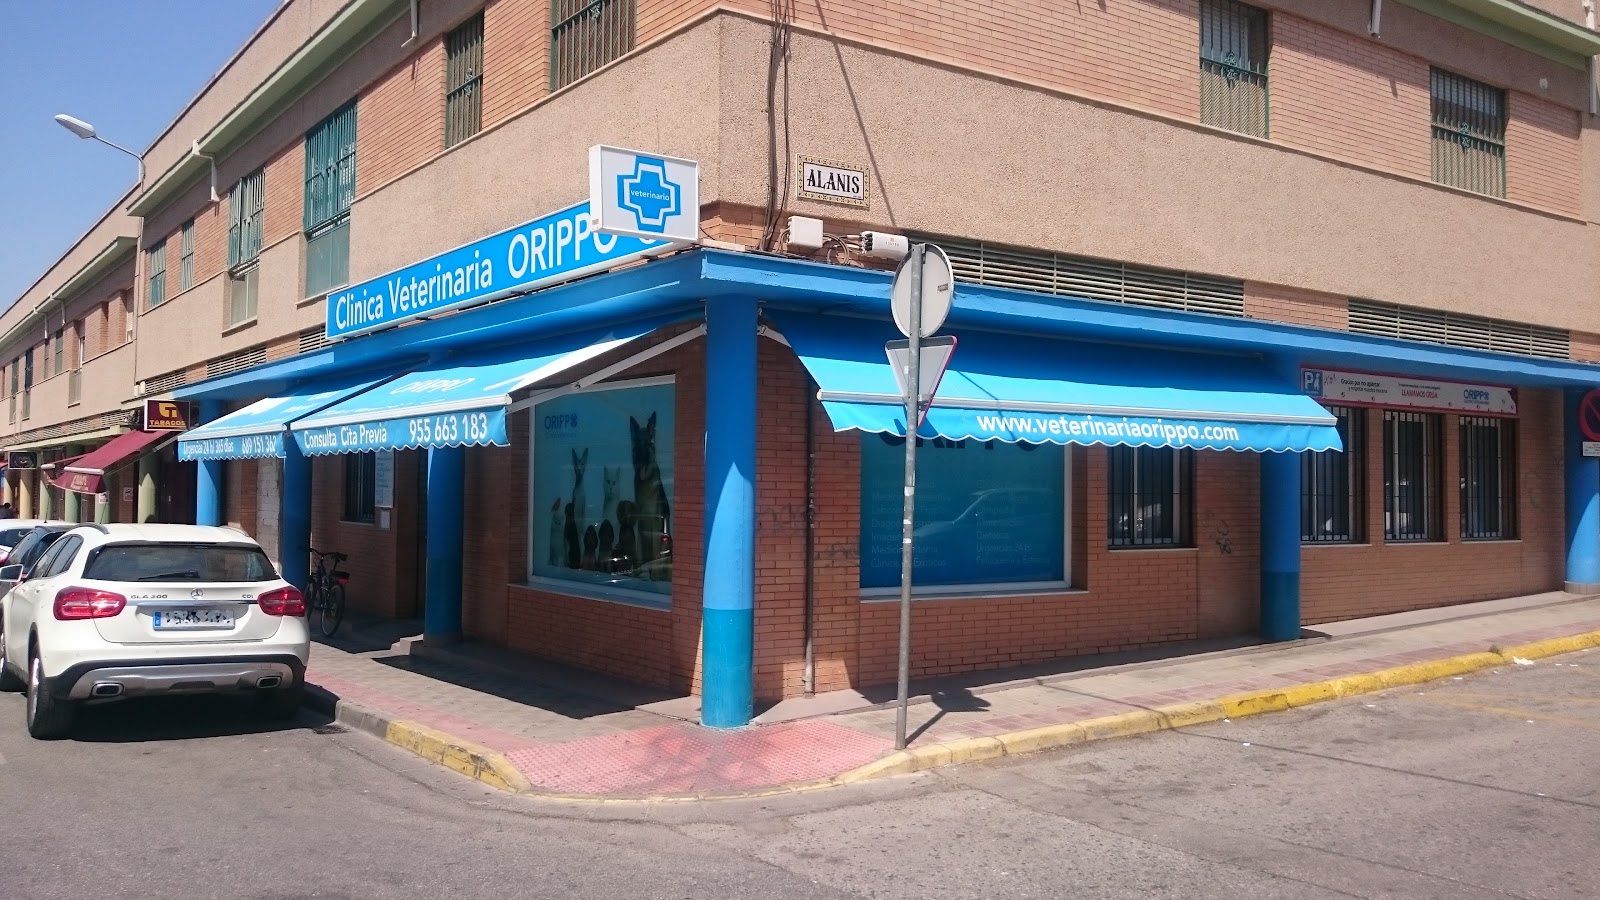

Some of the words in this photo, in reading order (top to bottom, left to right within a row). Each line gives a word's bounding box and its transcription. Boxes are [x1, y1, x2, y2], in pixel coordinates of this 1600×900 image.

[630, 189, 670, 201] veterinario
[806, 169, 860, 194] ALANIS
[388, 251, 492, 316] Veterinaria
[303, 427, 337, 449] Consulta
[340, 426, 358, 447] Cita
[359, 422, 387, 444] Previa
[409, 418, 431, 443] 955
[434, 415, 458, 442] 663
[462, 412, 488, 440] 183
[975, 414, 1240, 444] www.veterinariaorippo.com
[183, 440, 203, 458] Urgencias
[241, 438, 253, 455] 689
[253, 437, 264, 454] 151
